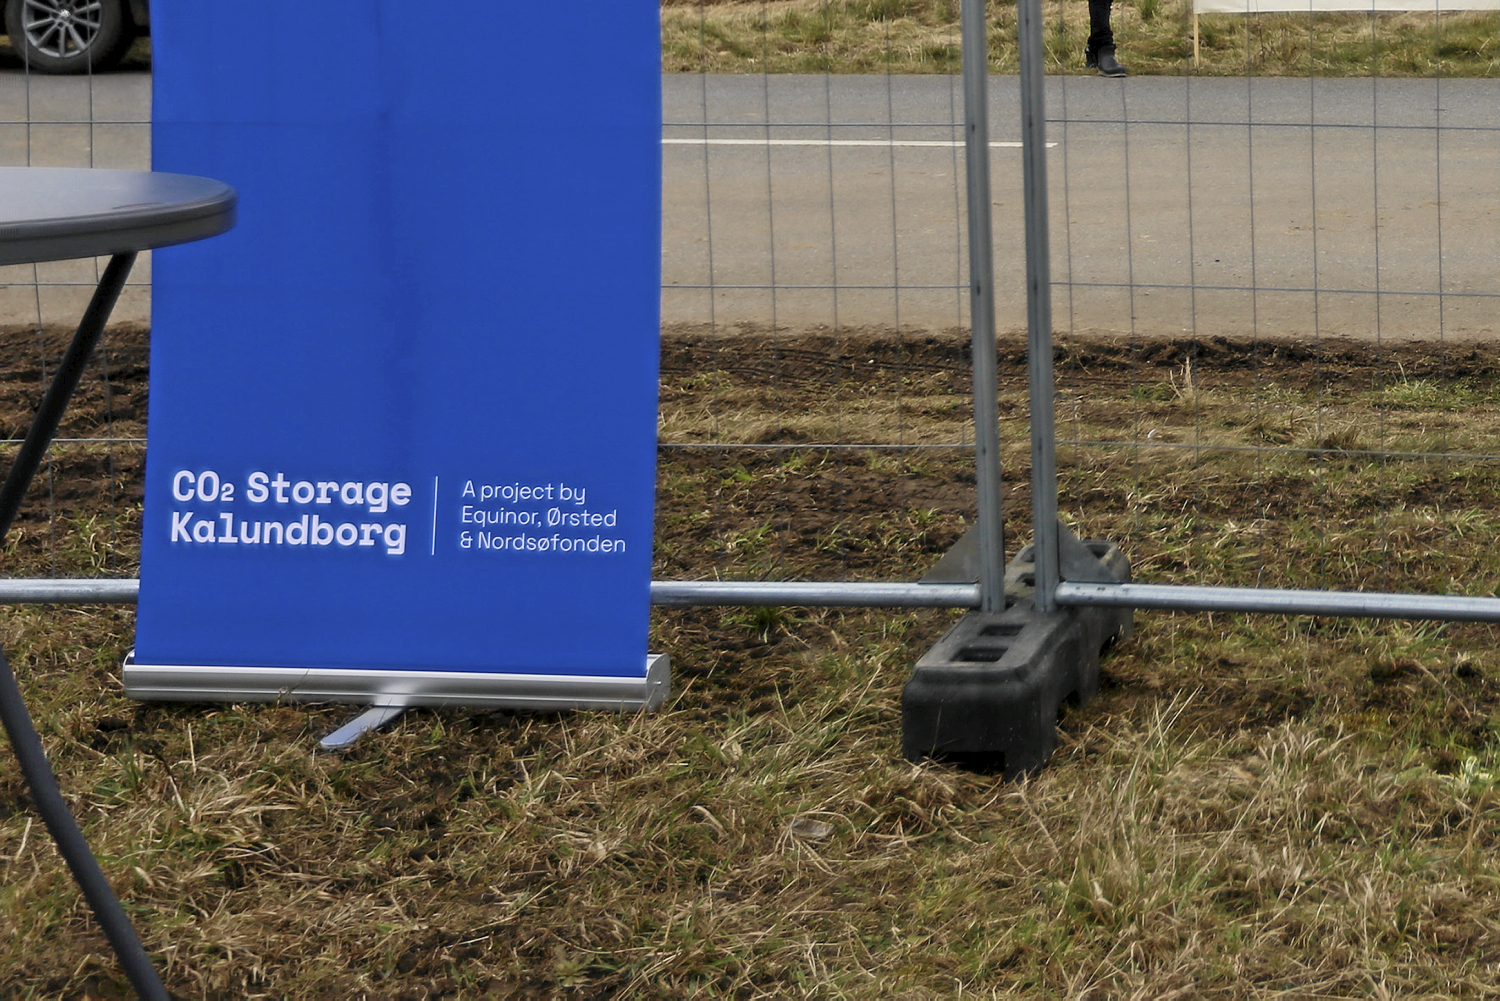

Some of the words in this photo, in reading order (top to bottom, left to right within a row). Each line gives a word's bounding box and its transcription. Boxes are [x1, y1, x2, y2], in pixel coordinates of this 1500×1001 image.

[172, 469, 235, 502] CO2
[246, 471, 412, 513] Storage
[462, 480, 476, 498] A
[480, 482, 555, 504] project
[559, 482, 586, 505] by
[461, 505, 543, 528] Equinor,
[547, 506, 617, 527] Ørsted
[170, 511, 407, 555] Kalundborg
[460, 530, 474, 549] &
[478, 531, 626, 553] Nordsøfonden
